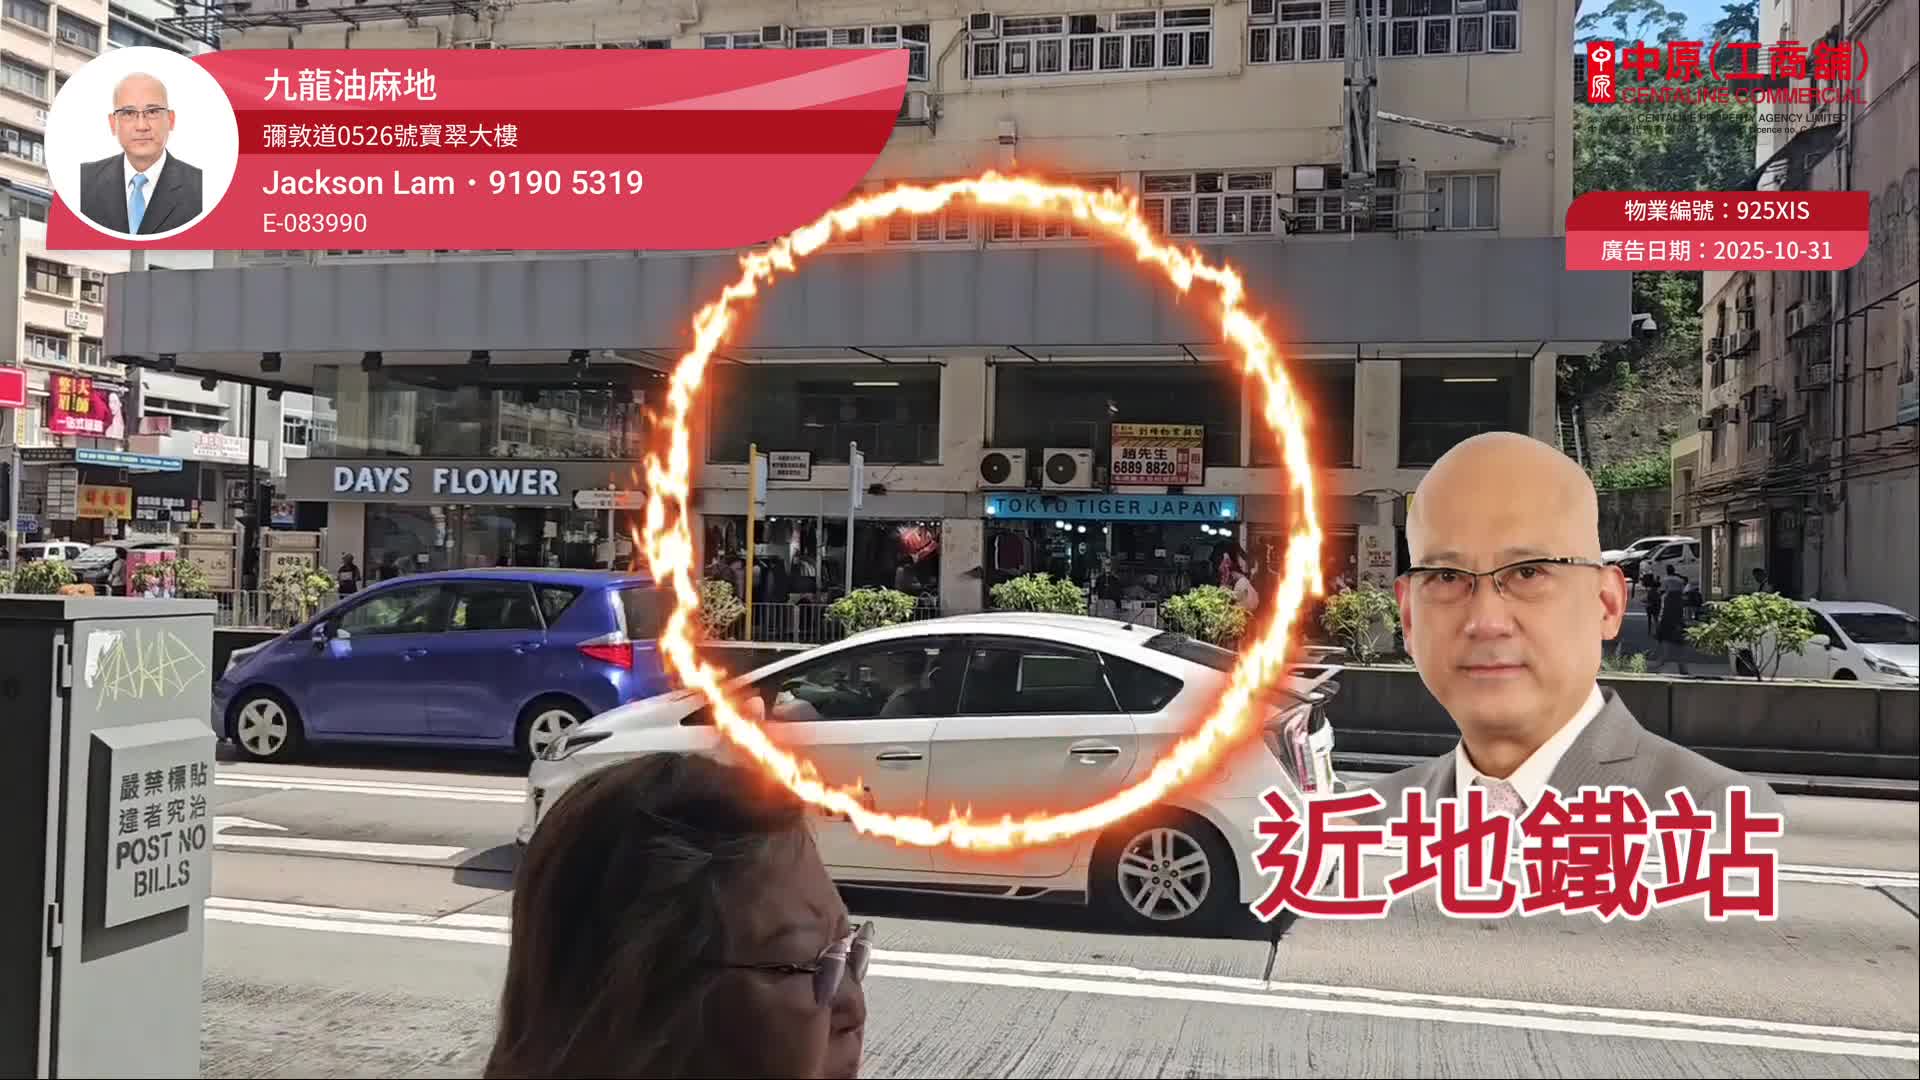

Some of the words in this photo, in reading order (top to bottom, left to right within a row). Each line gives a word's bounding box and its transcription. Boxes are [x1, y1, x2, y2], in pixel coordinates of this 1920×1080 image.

[333, 466, 411, 493] DAYS
[433, 467, 560, 496] FLOWER
[1113, 461, 1142, 474] 6889
[1146, 461, 1175, 474] 8820
[996, 498, 1068, 514] TOKYO
[1079, 499, 1141, 515] TIGER
[1149, 500, 1223, 516] JAPAN
[120, 761, 208, 802] 嚴禁標貼
[119, 794, 207, 836] 違者究治
[116, 831, 173, 870] POST
[179, 824, 206, 854] NO
[134, 860, 190, 898] BILLS
